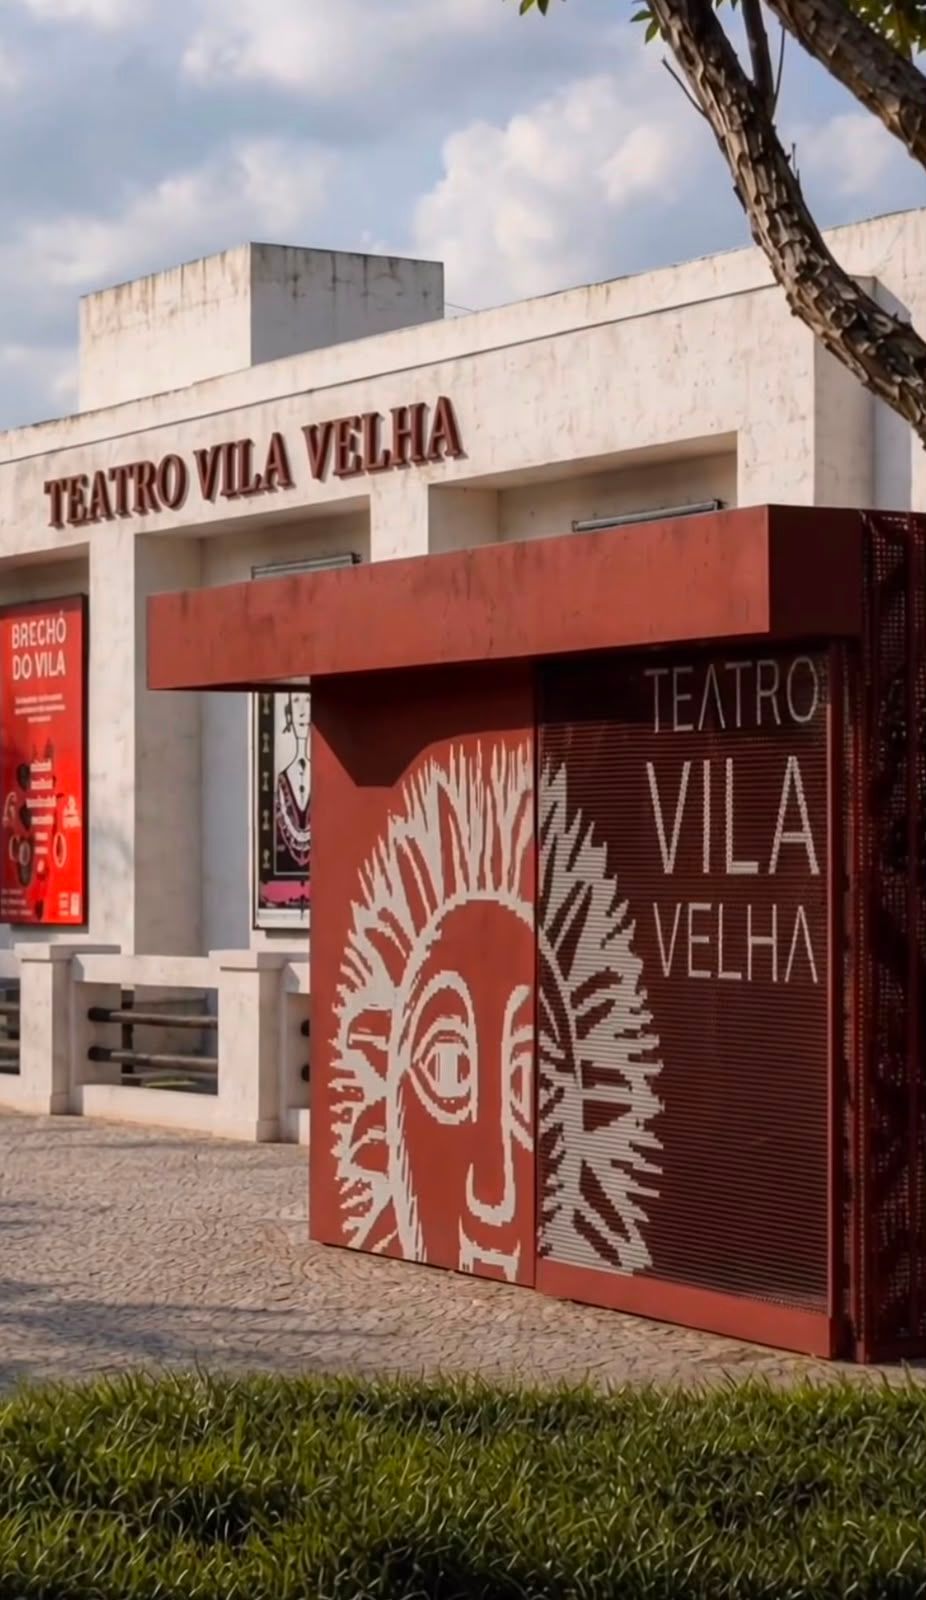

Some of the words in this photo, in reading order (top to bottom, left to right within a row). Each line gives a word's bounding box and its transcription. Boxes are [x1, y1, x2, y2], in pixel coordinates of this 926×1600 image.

[44, 453, 189, 529] TEATRO
[193, 432, 295, 500] VILA
[301, 396, 467, 481] VELHA
[11, 610, 67, 649] BRECHÓ
[12, 653, 32, 680] DO
[35, 649, 66, 678] VILA
[644, 656, 818, 733] TEATRO
[646, 755, 820, 875] VILA
[653, 902, 818, 983] VELHA
